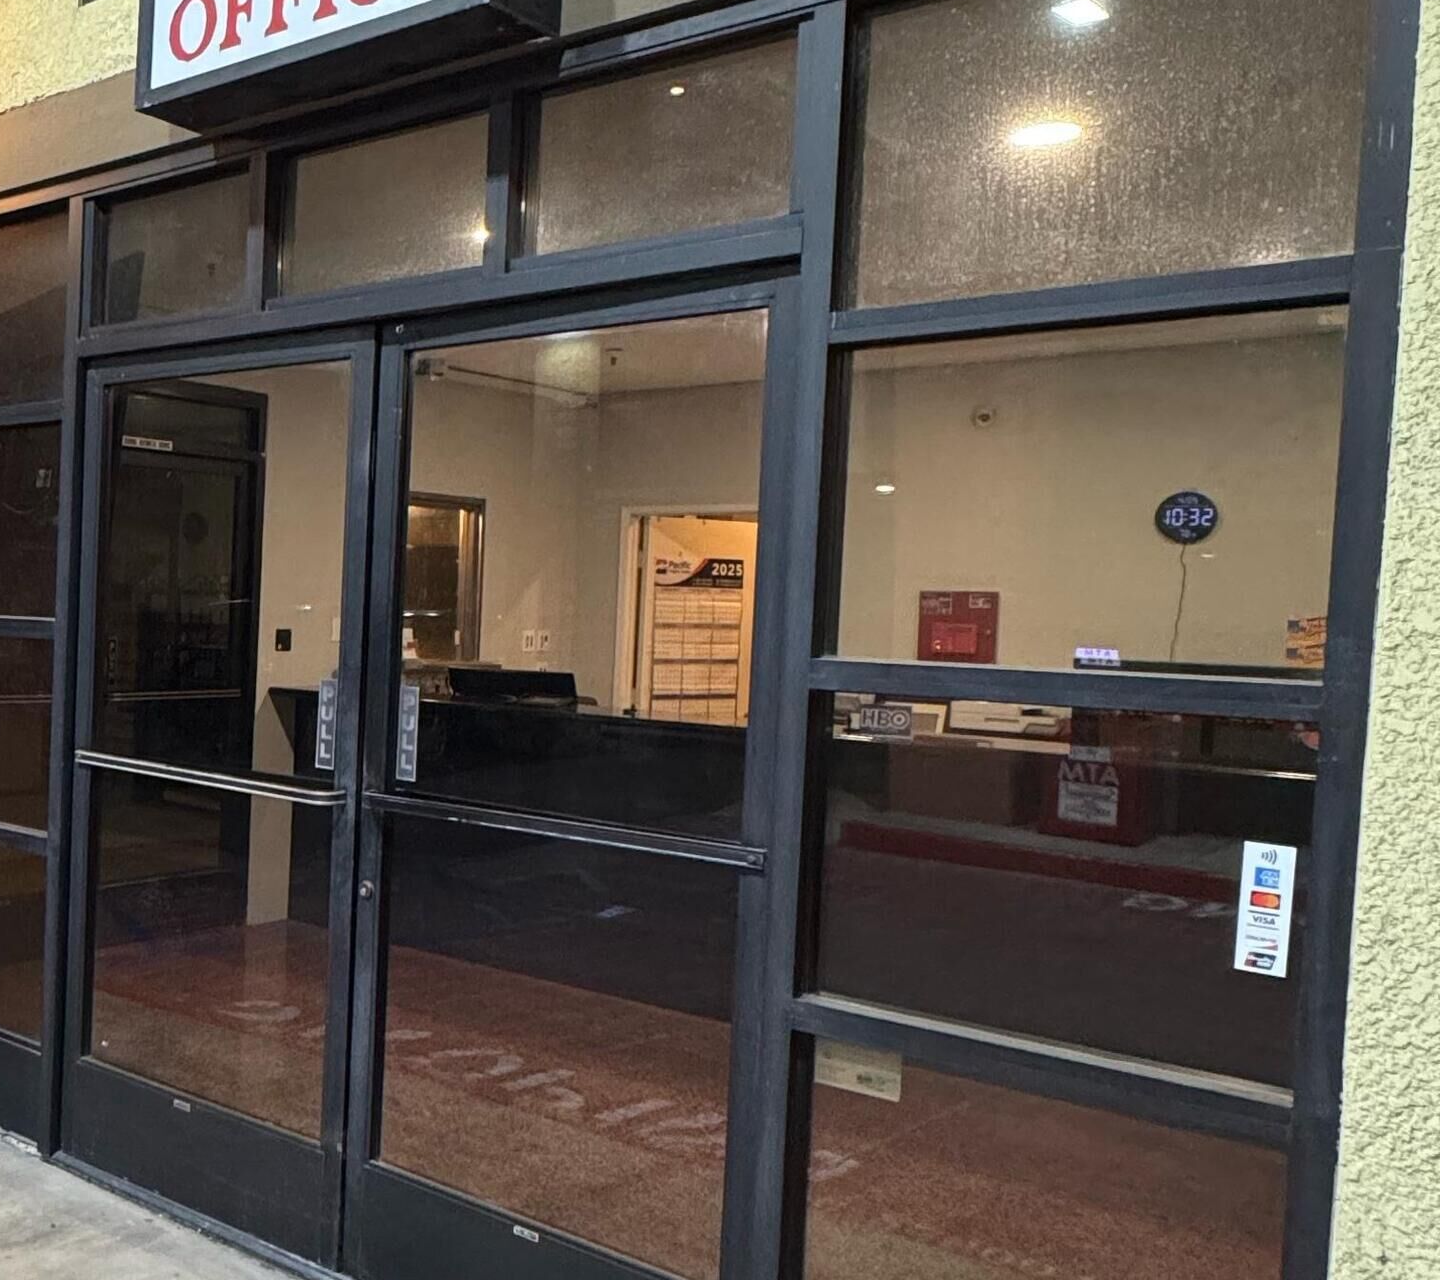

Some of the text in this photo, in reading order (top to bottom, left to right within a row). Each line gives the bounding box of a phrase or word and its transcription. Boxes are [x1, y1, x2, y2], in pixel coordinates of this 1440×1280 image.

[1162, 507, 1214, 526] 10:32
[711, 562, 743, 577] 2025
[319, 685, 334, 759] PULL
[861, 708, 910, 730] HBO
[399, 693, 415, 771] PULL
[1057, 760, 1119, 786] MTA
[1252, 915, 1276, 925] VISA
